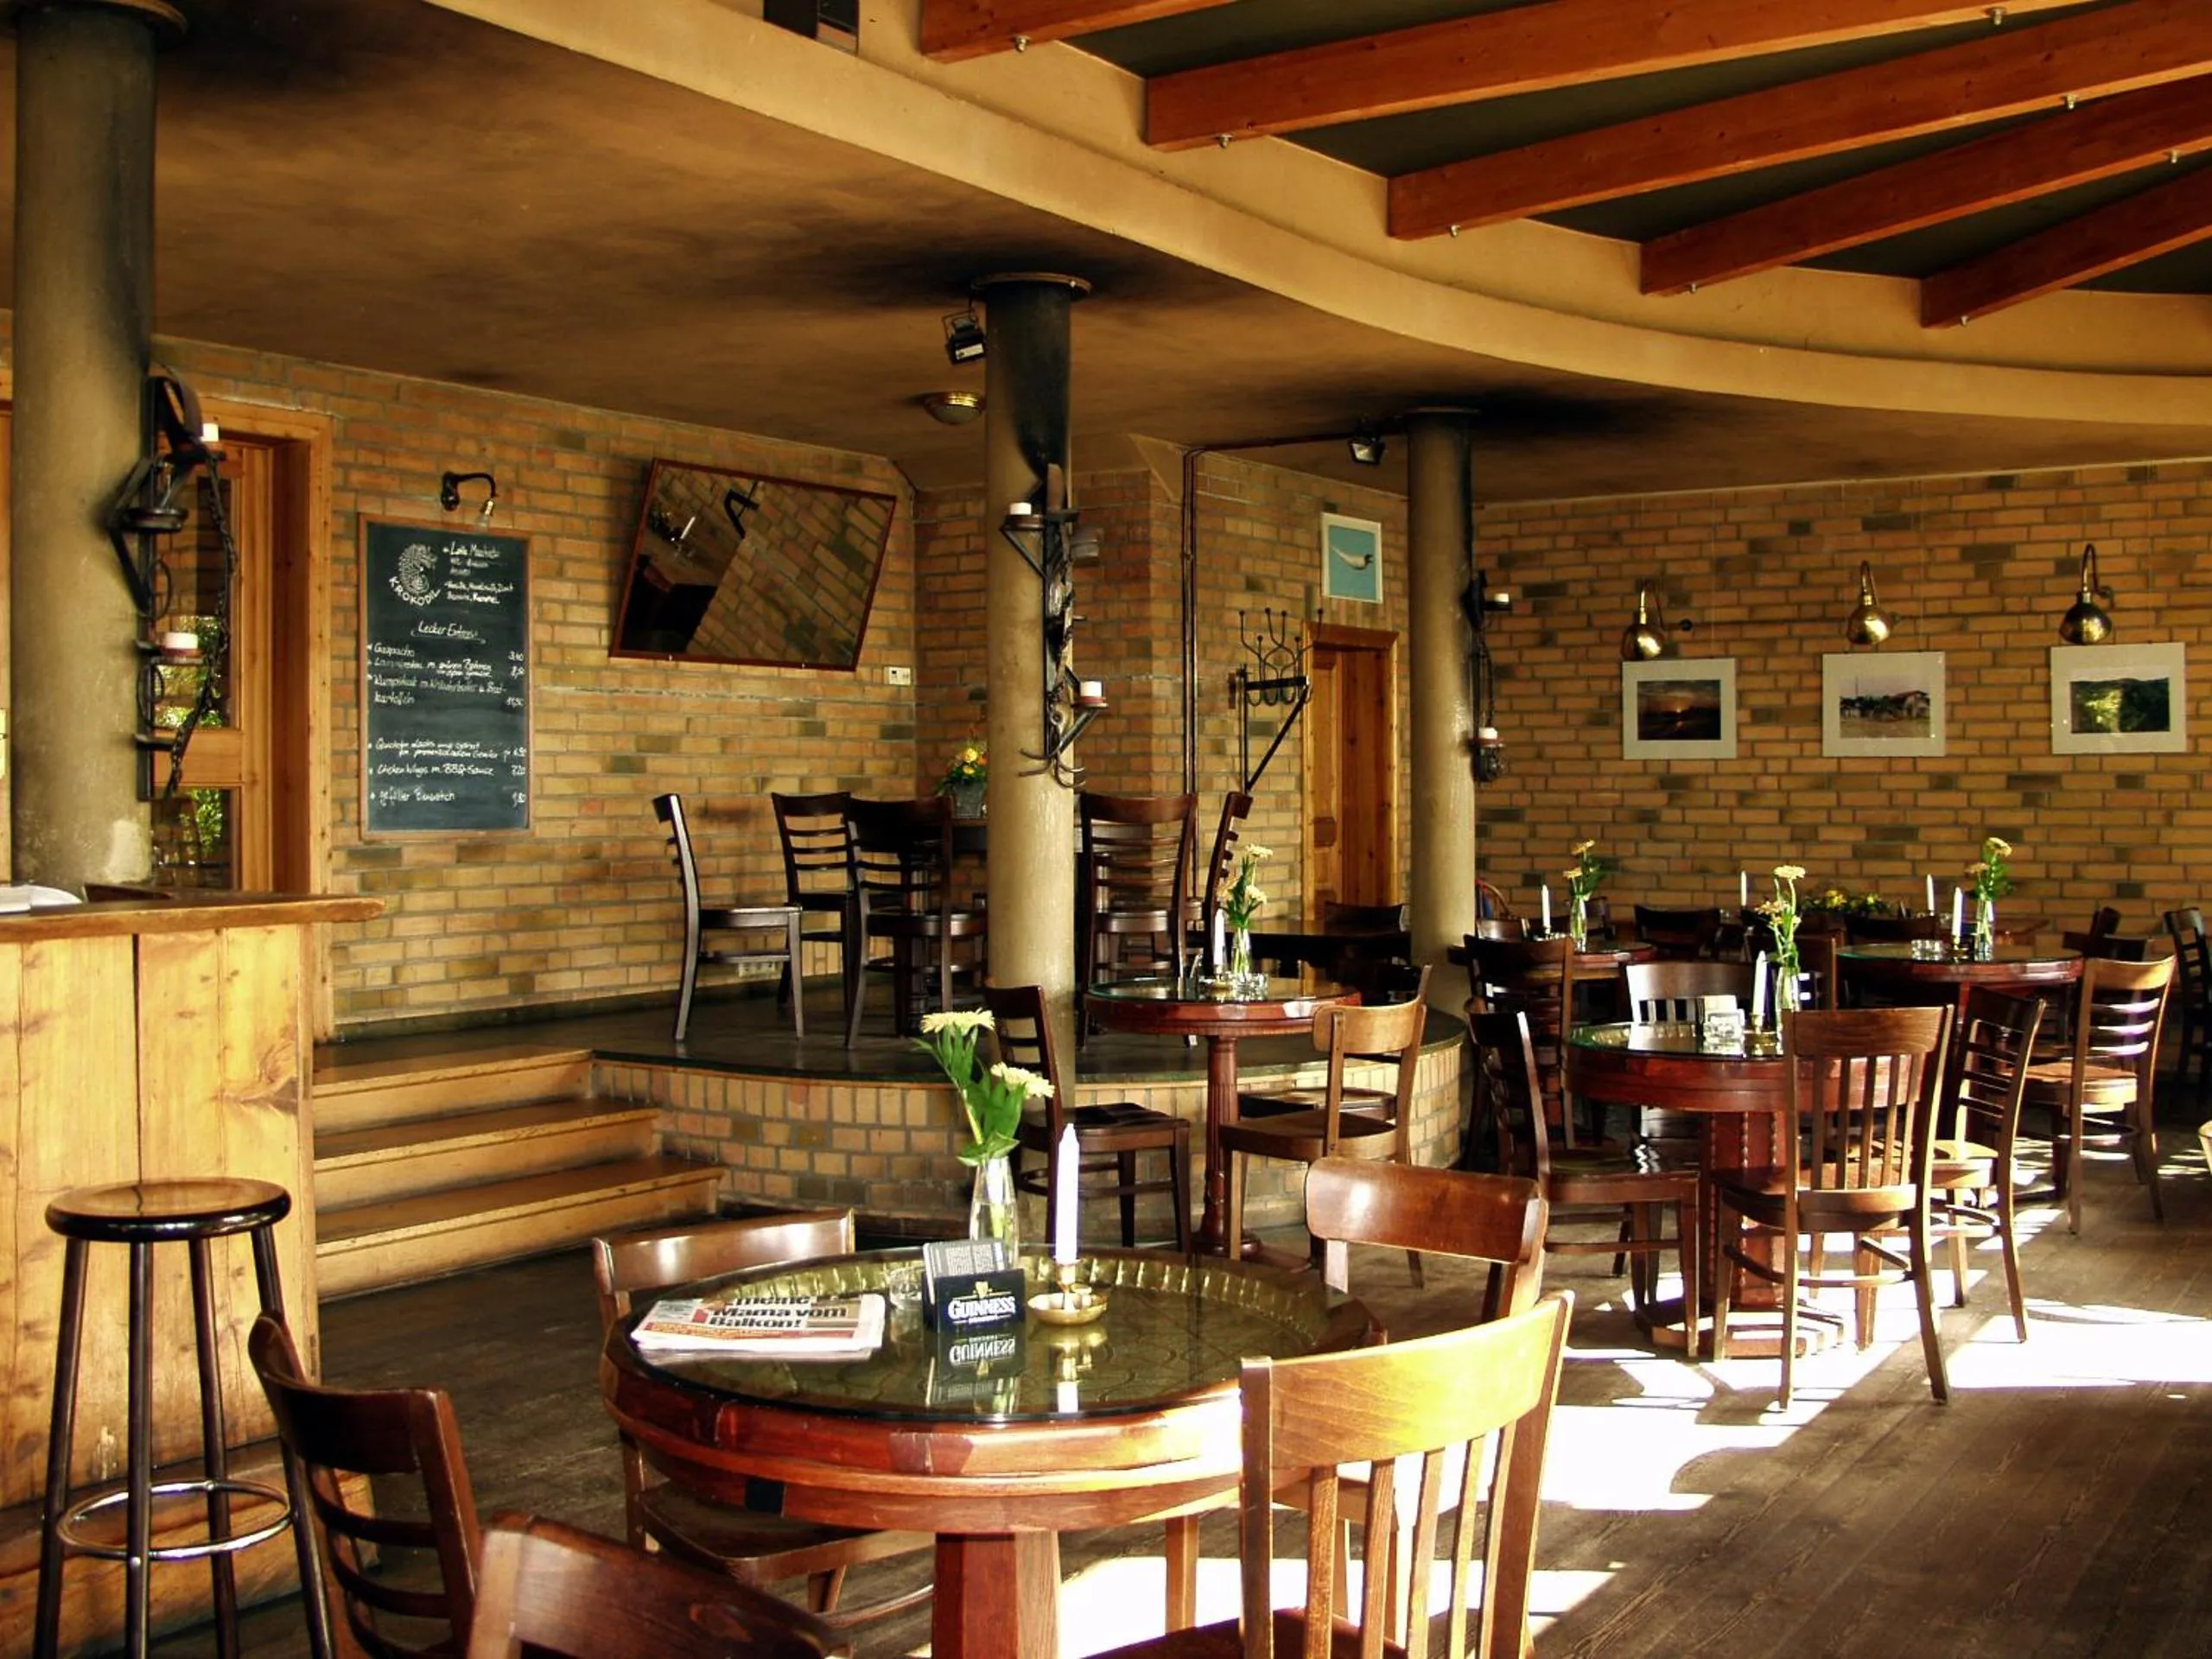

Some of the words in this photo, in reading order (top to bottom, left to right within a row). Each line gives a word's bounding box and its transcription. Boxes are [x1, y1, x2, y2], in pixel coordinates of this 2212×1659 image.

[389, 576, 441, 606] KROKODIL
[713, 1307, 791, 1317] Mama
[795, 1307, 848, 1318] vom
[948, 1296, 1015, 1320] GUINNESS
[709, 1317, 802, 1328] Balkon!
